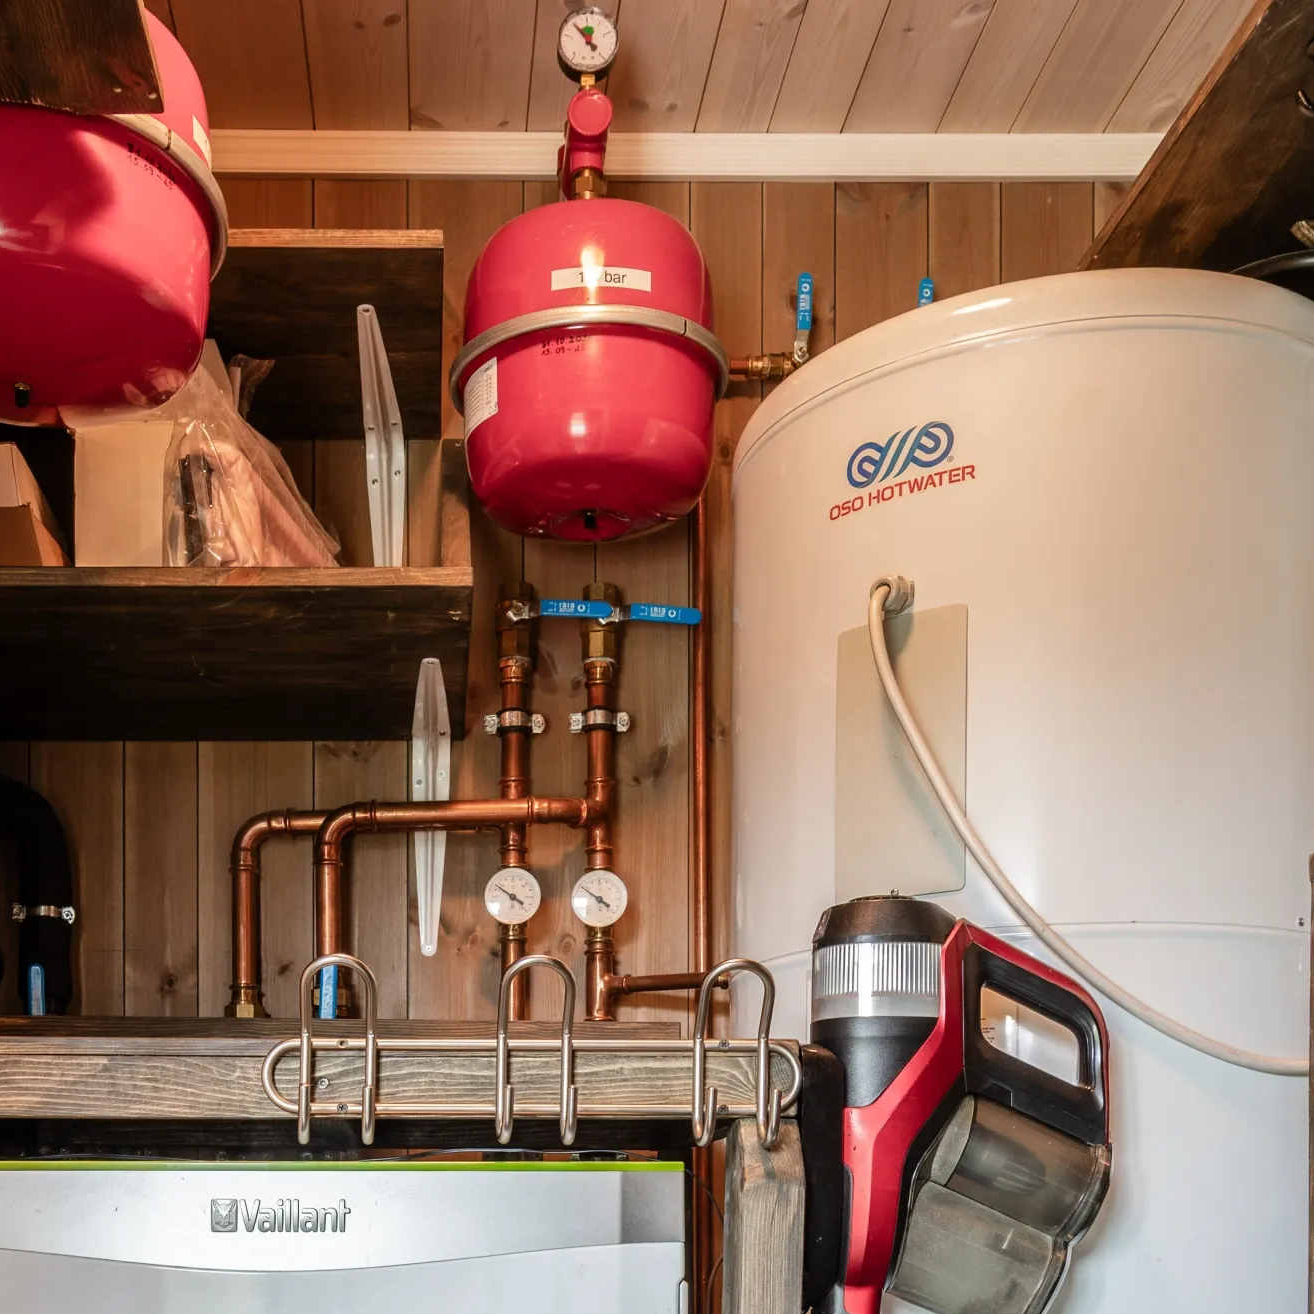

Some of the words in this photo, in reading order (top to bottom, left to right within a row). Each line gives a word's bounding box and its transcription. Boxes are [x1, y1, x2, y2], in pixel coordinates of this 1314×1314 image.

[604, 270, 627, 284] bar
[829, 496, 864, 521] OSO
[868, 464, 976, 507] HOTWATER
[238, 1198, 352, 1233] Vaillant
